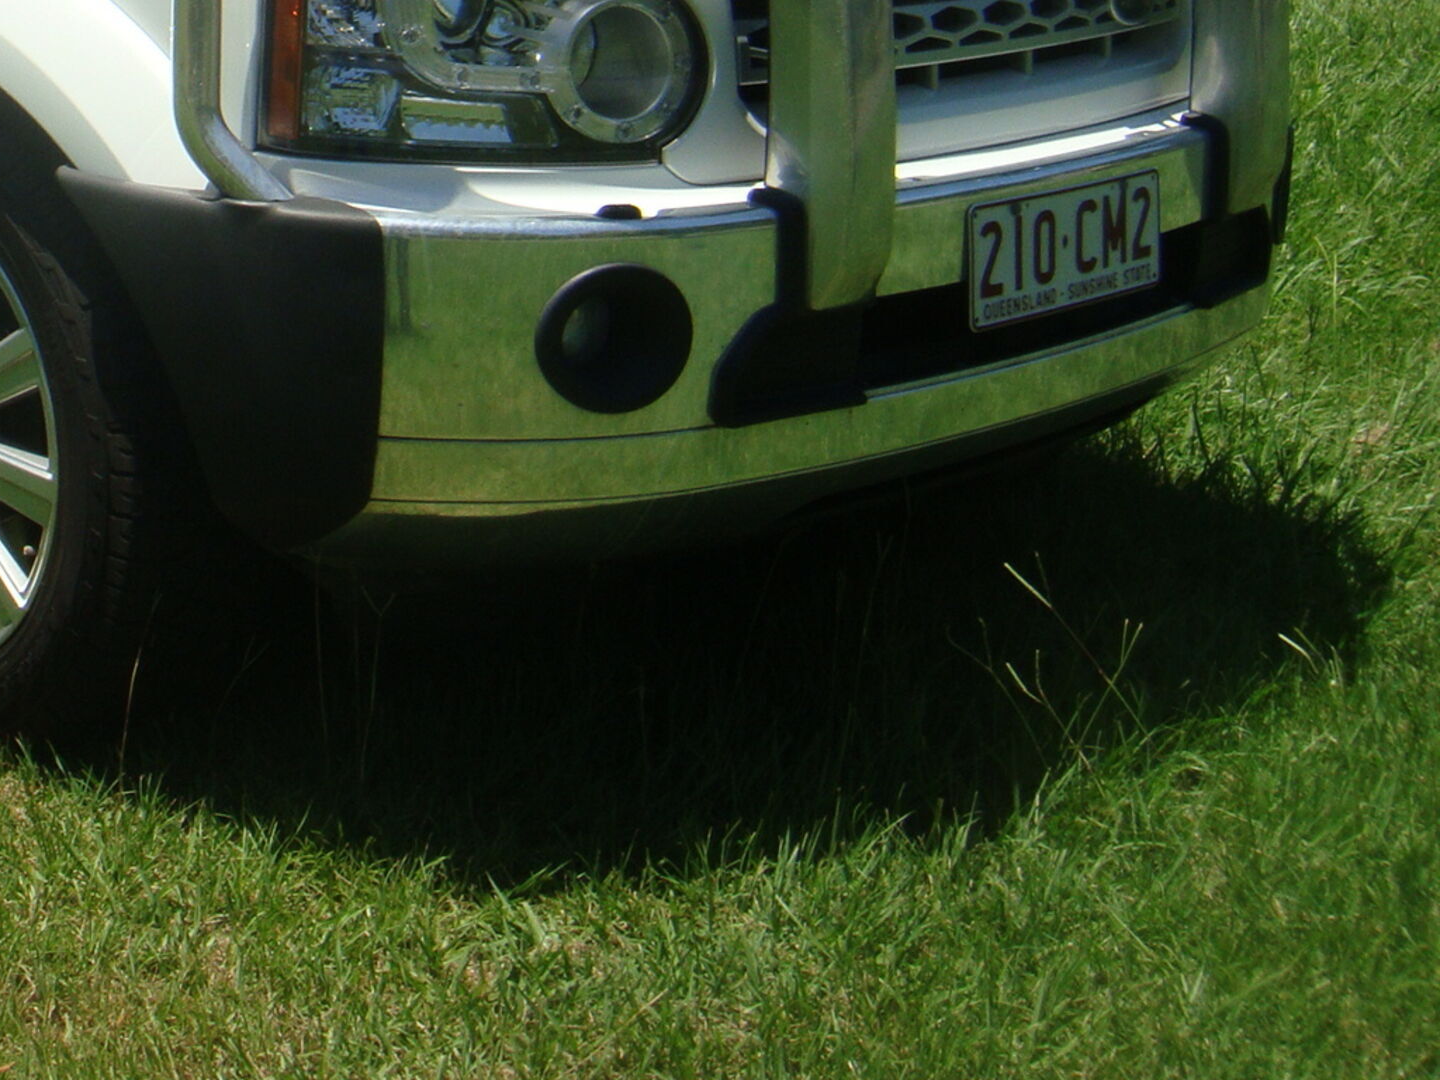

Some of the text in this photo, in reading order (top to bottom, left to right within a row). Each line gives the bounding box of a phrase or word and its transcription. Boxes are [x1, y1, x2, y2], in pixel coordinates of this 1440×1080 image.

[983, 263, 1152, 320] QUEENSLAND SUNSHINE STATE
